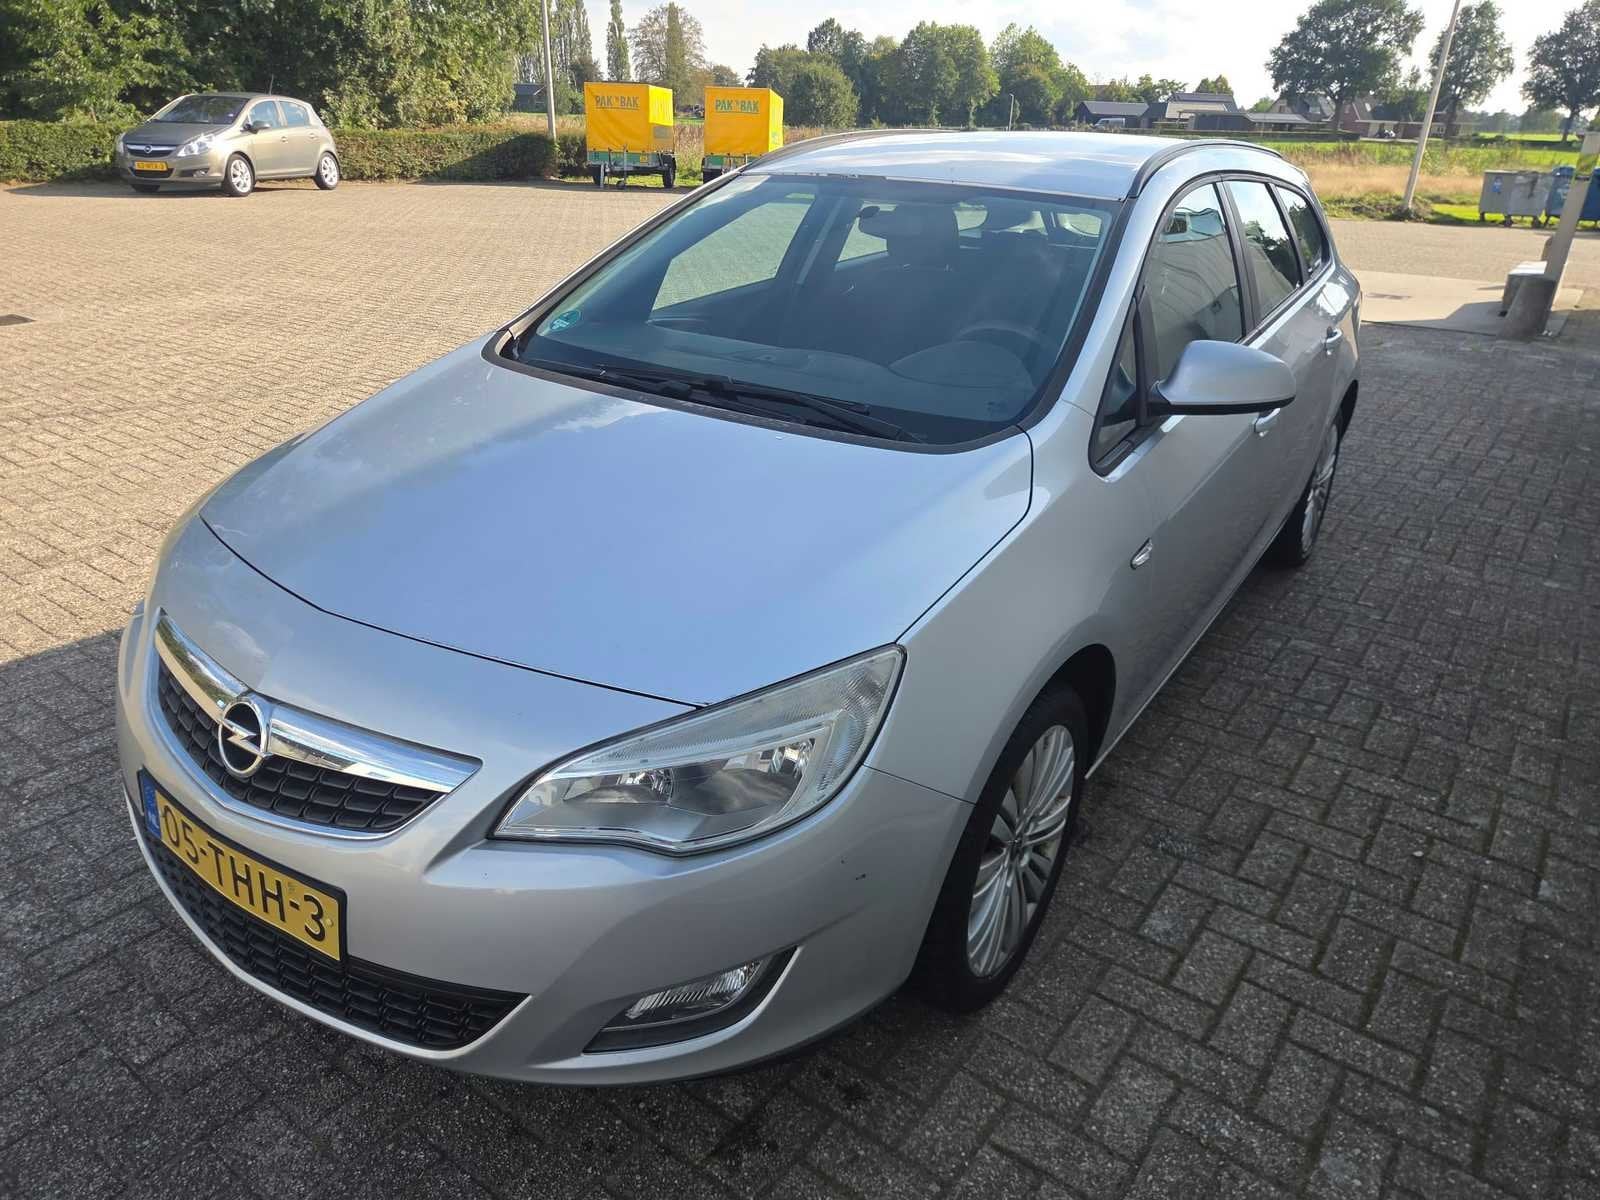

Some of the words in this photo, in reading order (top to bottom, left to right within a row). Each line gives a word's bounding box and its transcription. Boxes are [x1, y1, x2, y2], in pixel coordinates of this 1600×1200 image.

[595, 96, 613, 107] PAK
[620, 96, 640, 108] BAK
[715, 99, 733, 112] PAK
[740, 100, 760, 113] BAK
[163, 804, 326, 942] 05-THH-3
